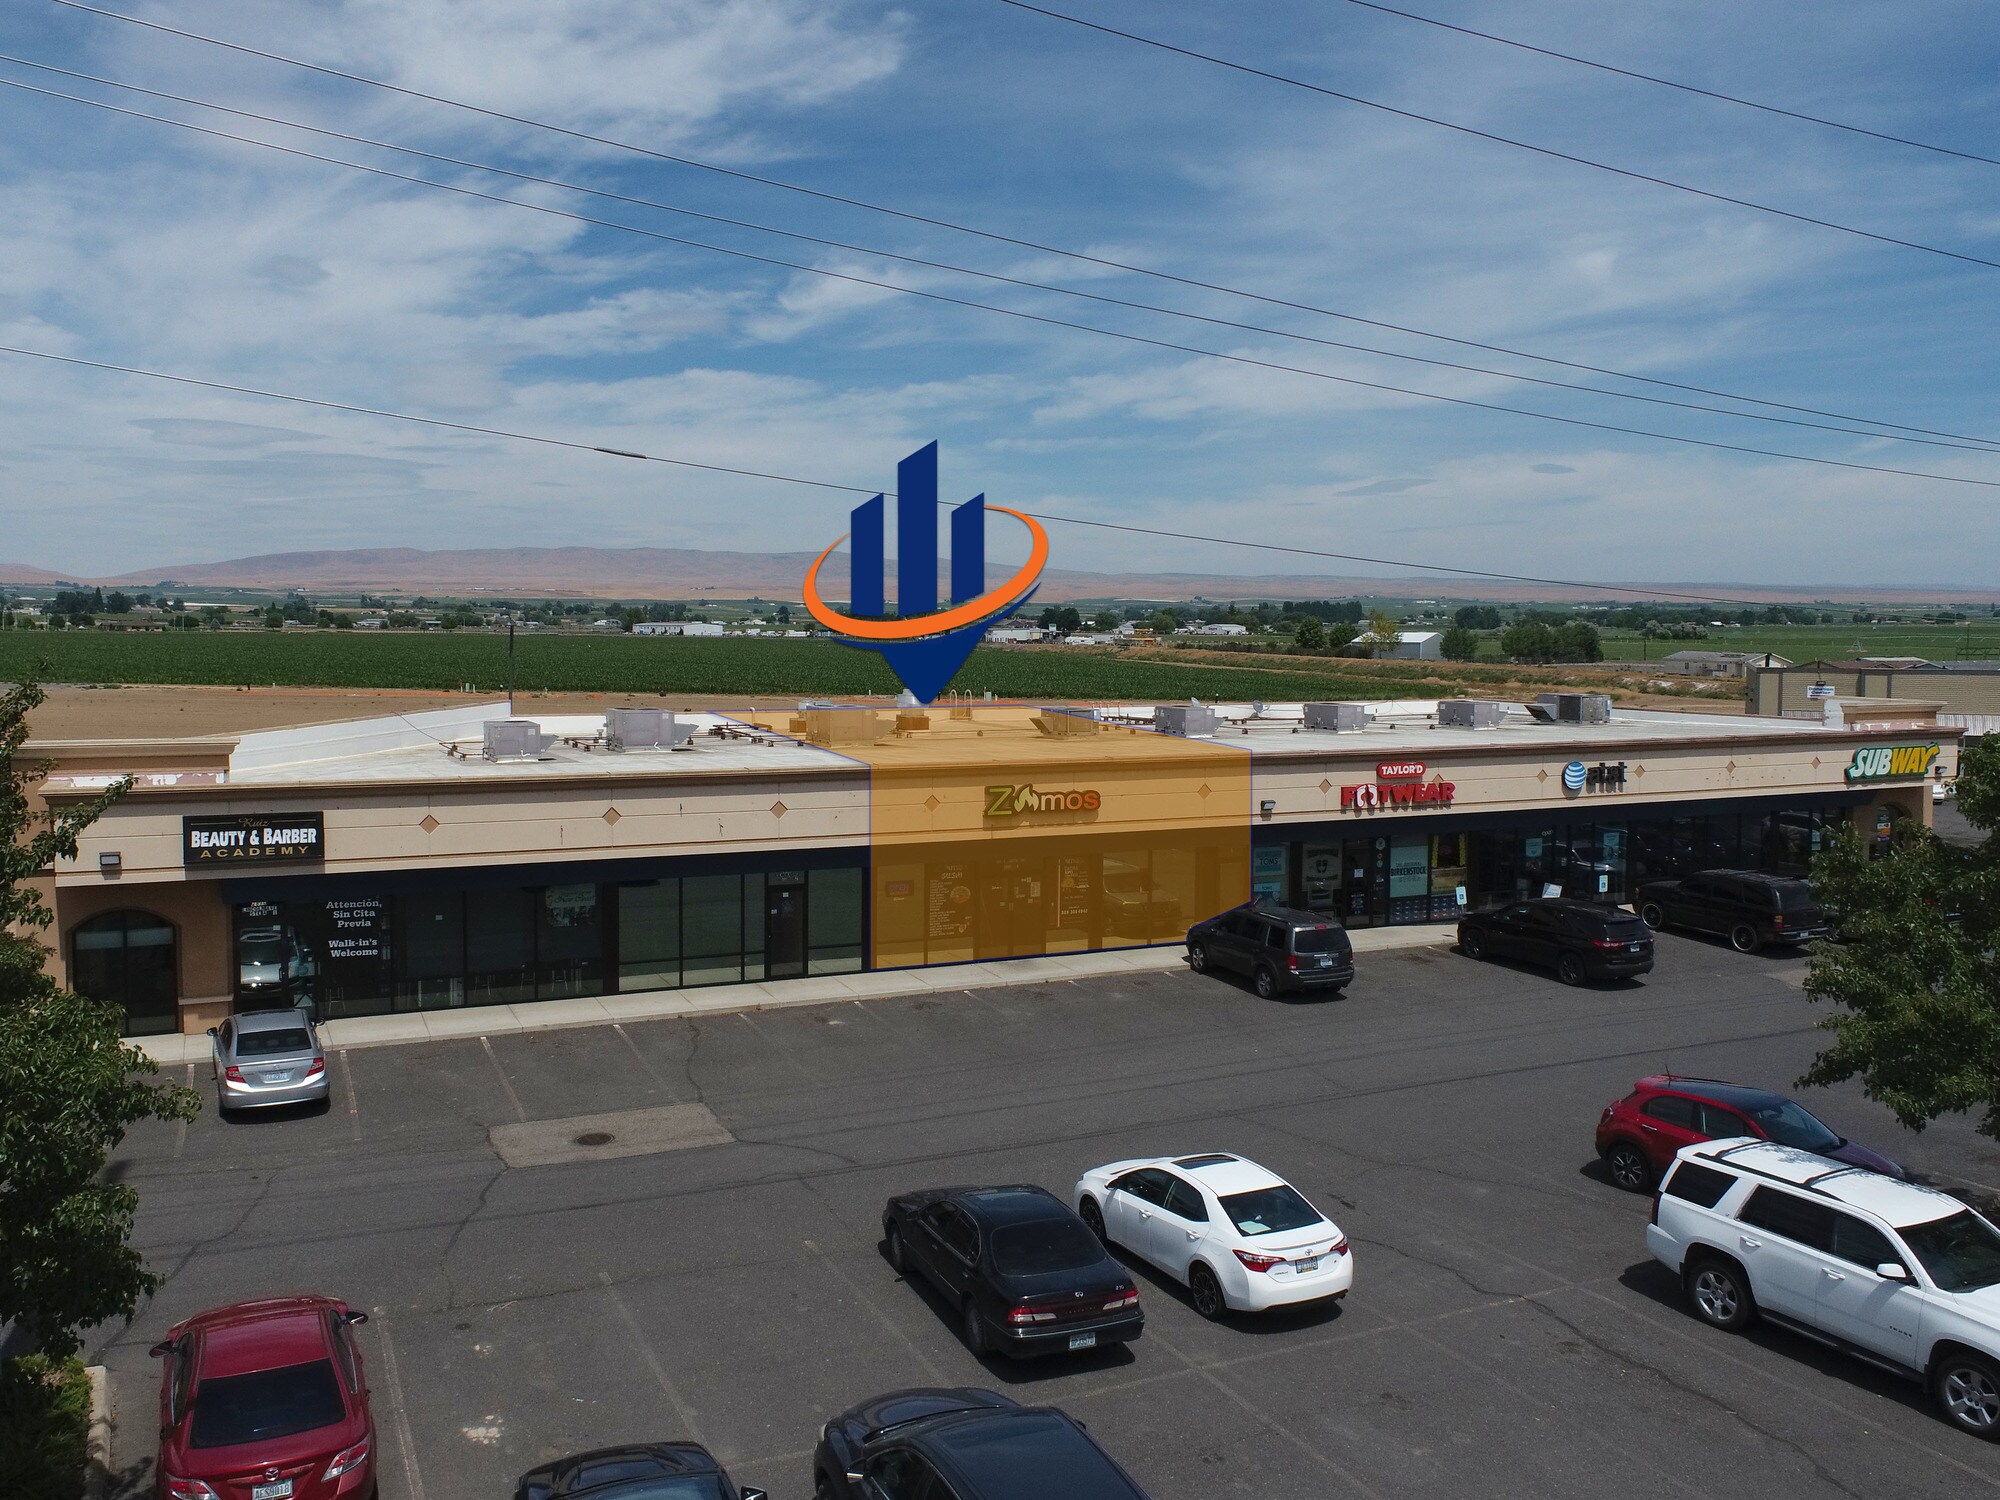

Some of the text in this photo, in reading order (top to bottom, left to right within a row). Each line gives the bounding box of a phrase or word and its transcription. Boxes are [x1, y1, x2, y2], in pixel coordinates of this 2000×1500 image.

[1848, 743, 1940, 778] SUBWAY
[1382, 764, 1424, 775] TAYLOR'D
[191, 827, 317, 848] BEAUTY & BARBER
[200, 846, 309, 858] ACADEMY
[333, 909, 376, 919] Sin Cita
[337, 919, 371, 928] Previa
[328, 938, 378, 948] Walk-in's
[330, 949, 378, 958] Welcome
